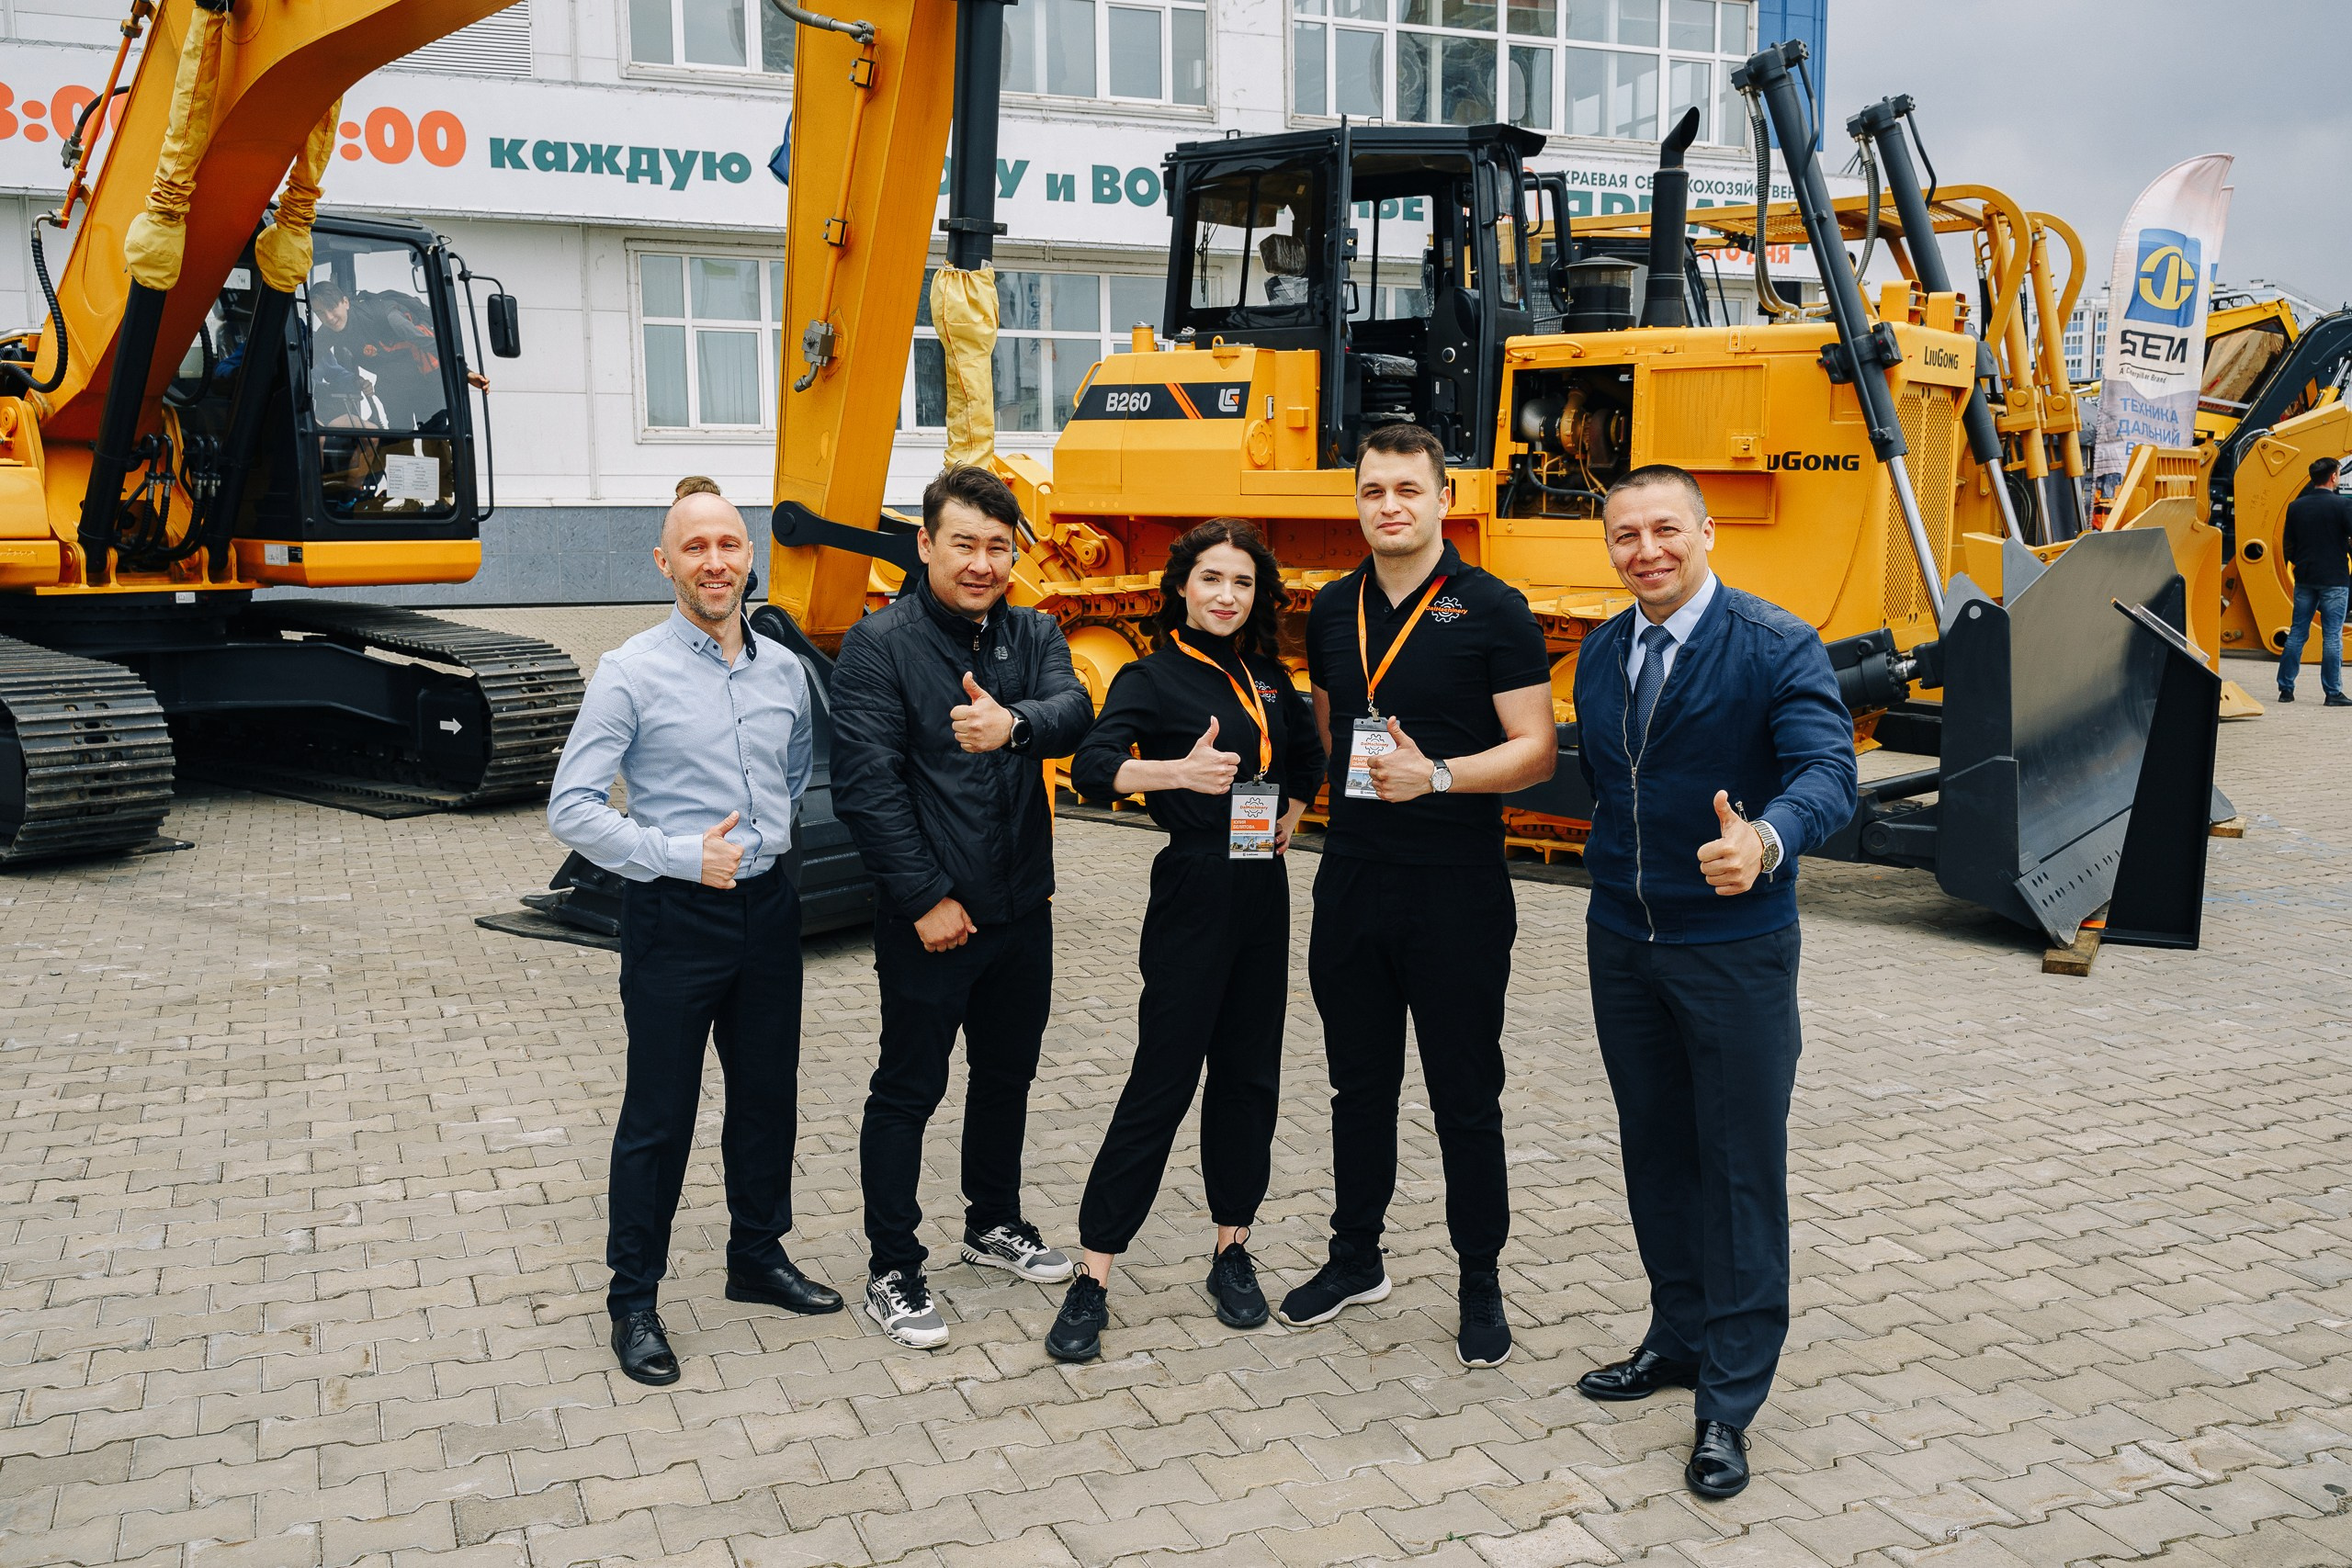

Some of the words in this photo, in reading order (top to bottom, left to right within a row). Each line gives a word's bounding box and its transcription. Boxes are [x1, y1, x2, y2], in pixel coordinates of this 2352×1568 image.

[334, 107, 466, 167] :00
[490, 137, 752, 191] каждую
[1046, 173, 1075, 202] и
[2120, 330, 2188, 364] SEM
[1105, 391, 1151, 412] B260
[2120, 398, 2178, 424] ТЕХНИКА
[2116, 419, 2181, 446] ДАЛЬНИЙ
